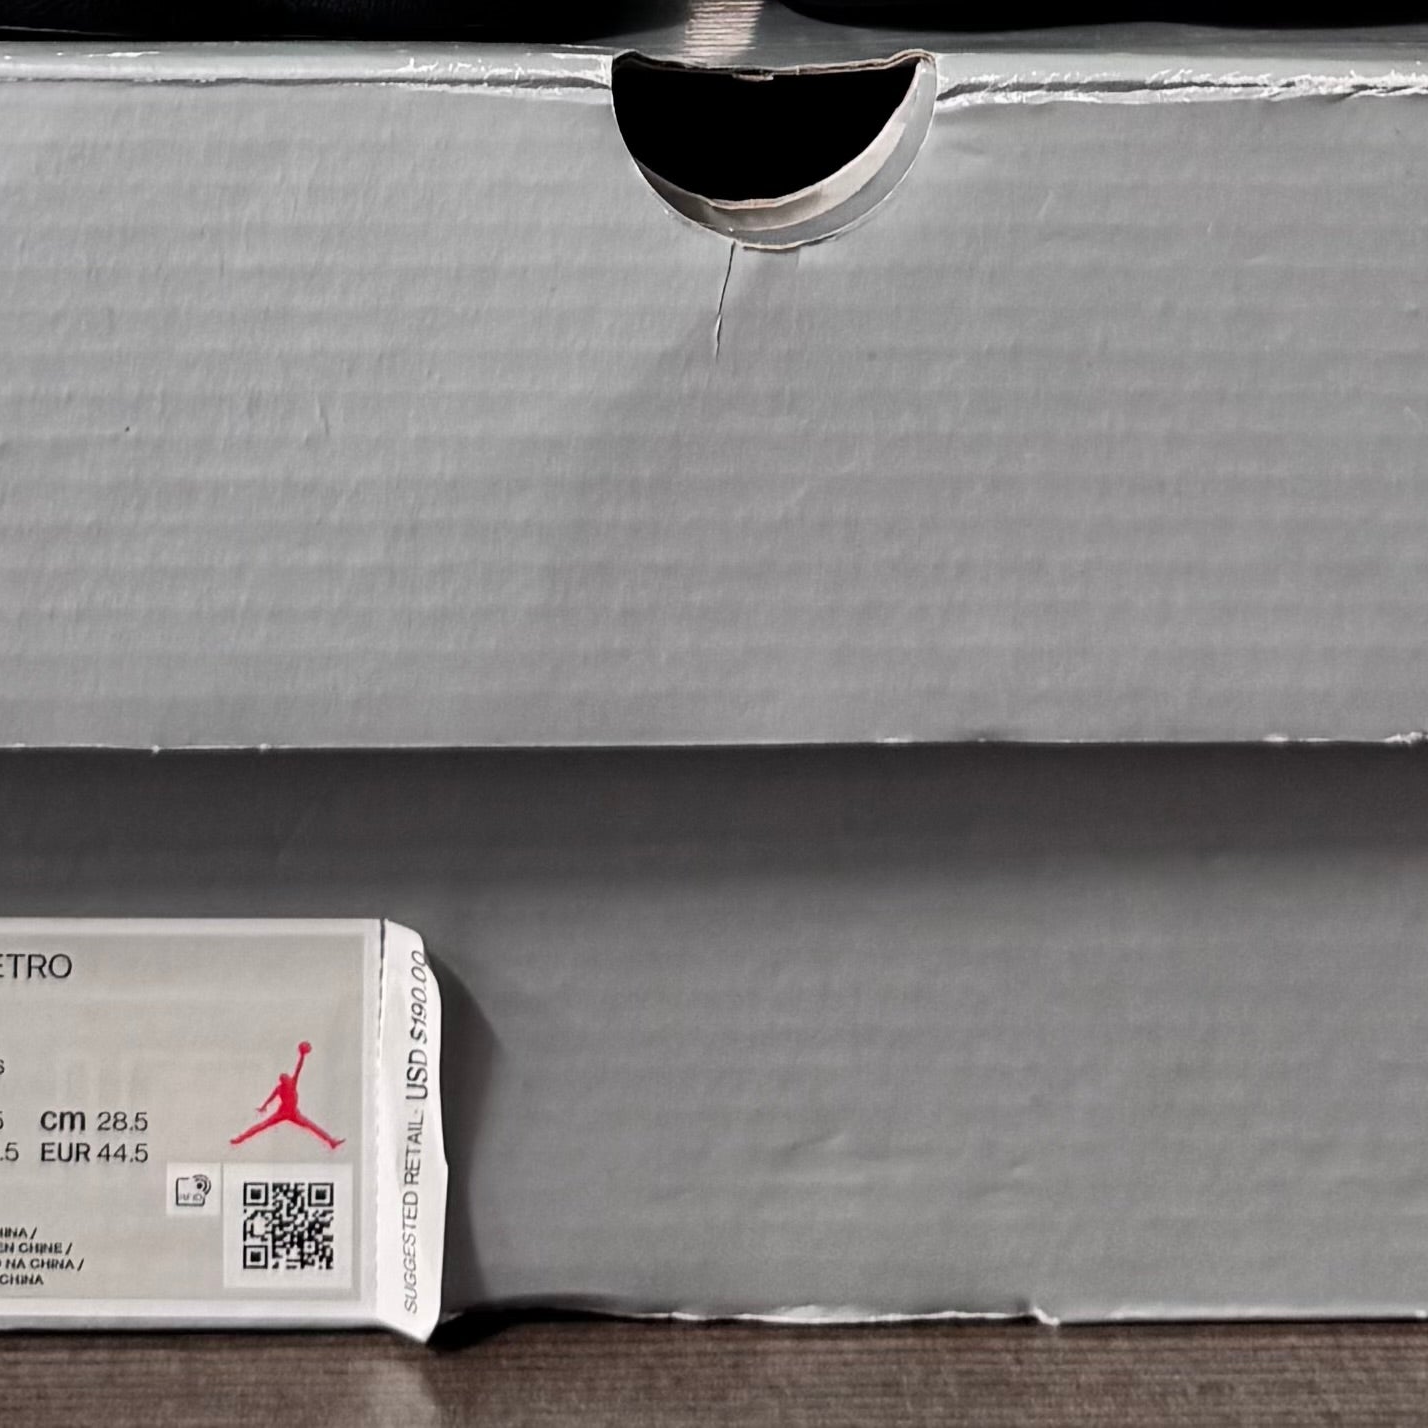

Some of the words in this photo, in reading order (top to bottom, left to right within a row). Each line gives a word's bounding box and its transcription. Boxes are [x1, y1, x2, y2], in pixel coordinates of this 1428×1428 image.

[405, 1050, 429, 1101] USD
[40, 1110, 87, 1132] cm
[96, 1111, 149, 1132] 28.5
[40, 1142, 91, 1163] EUR
[96, 1143, 149, 1164] 44.5
[18, 1242, 63, 1254] CHINE
[401, 1191, 419, 1314] SUGGESTED
[6, 1258, 27, 1270] NA
[30, 1258, 75, 1270] CHINA
[0, 1273, 44, 1286] CHINA
